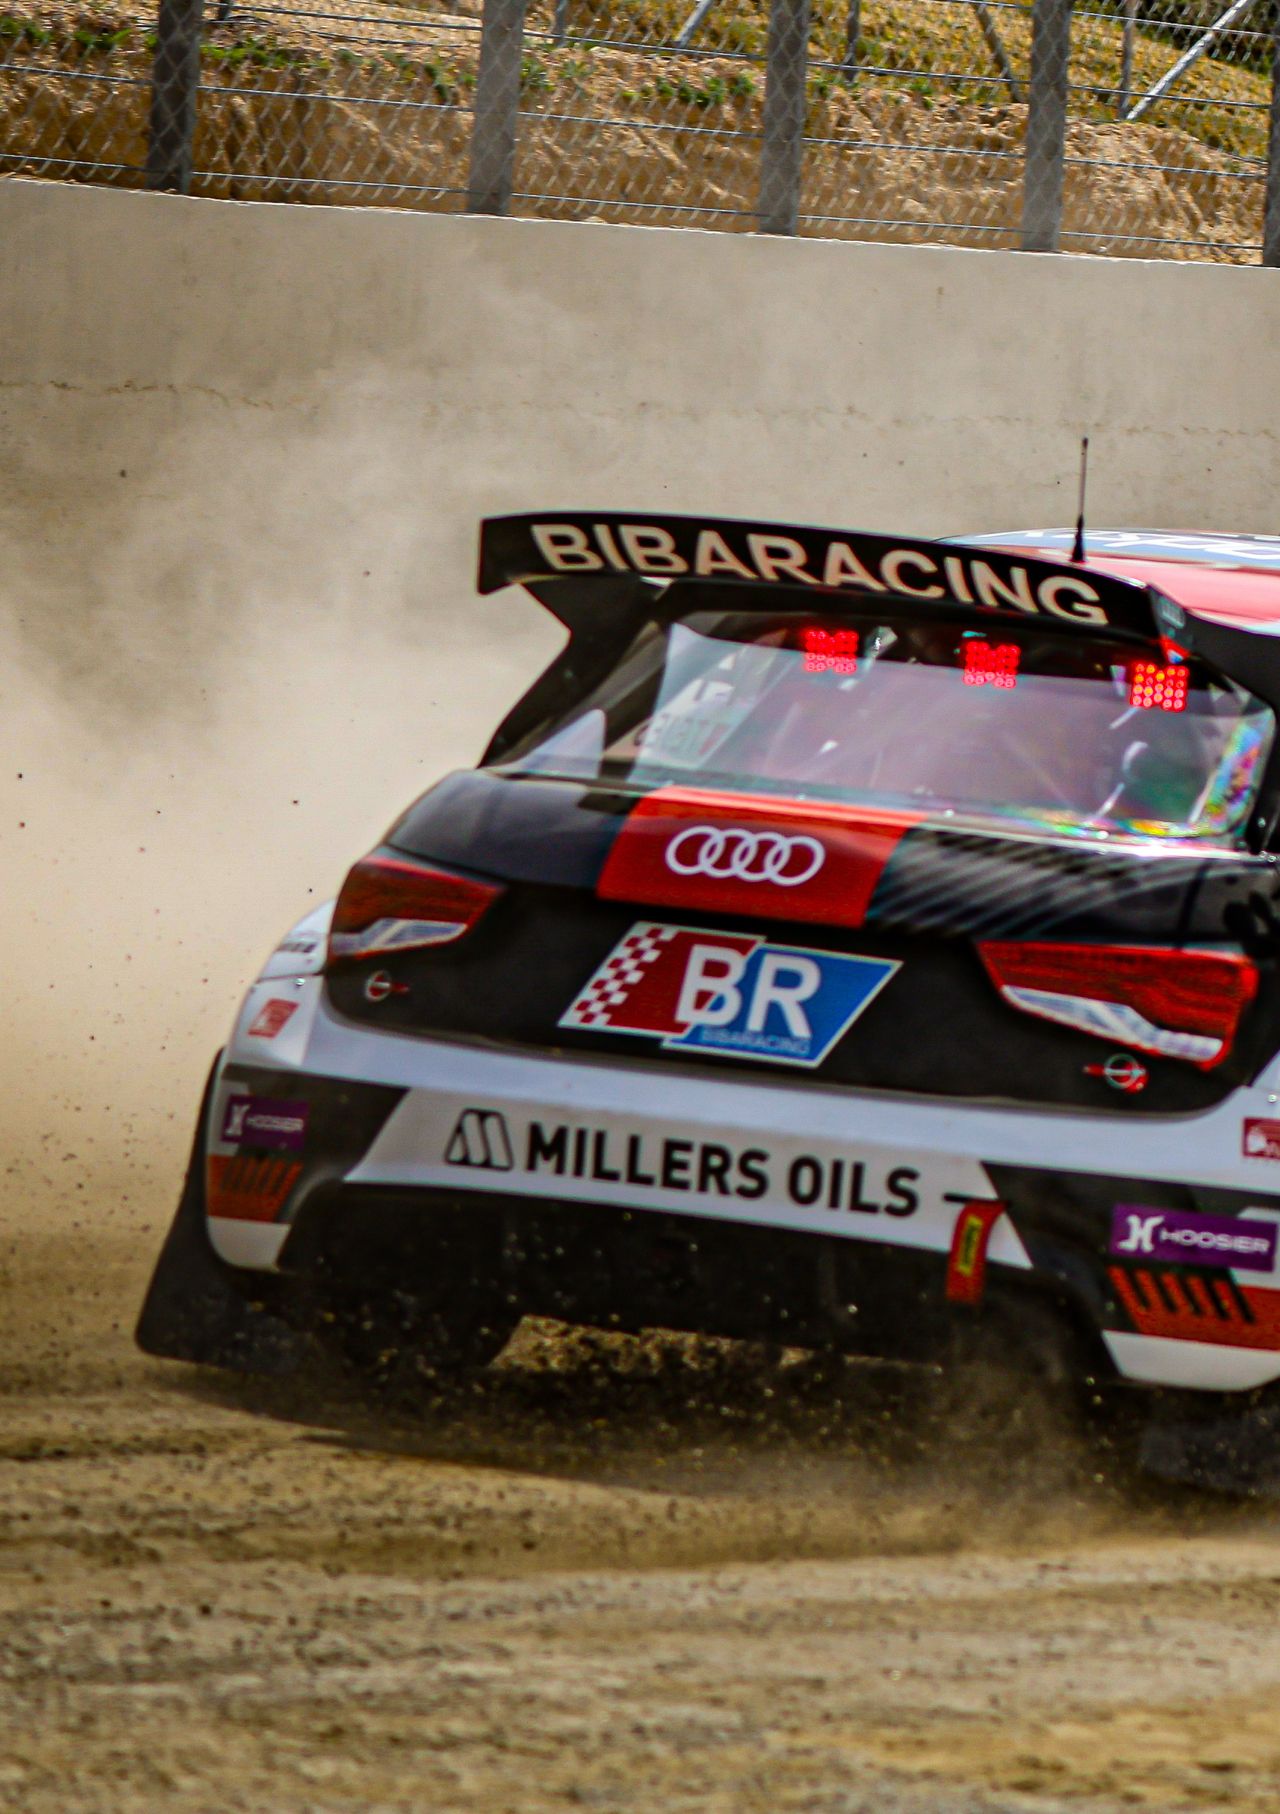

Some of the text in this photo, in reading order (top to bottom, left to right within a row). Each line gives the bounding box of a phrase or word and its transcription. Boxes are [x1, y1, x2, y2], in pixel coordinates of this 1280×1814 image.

[530, 521, 1110, 627] BIBARACING
[674, 943, 821, 1039] BR
[700, 1027, 811, 1055] BIBARACING
[525, 1120, 921, 1219] MILLERS OILS
[1158, 1228, 1271, 1256] HOOSIER
